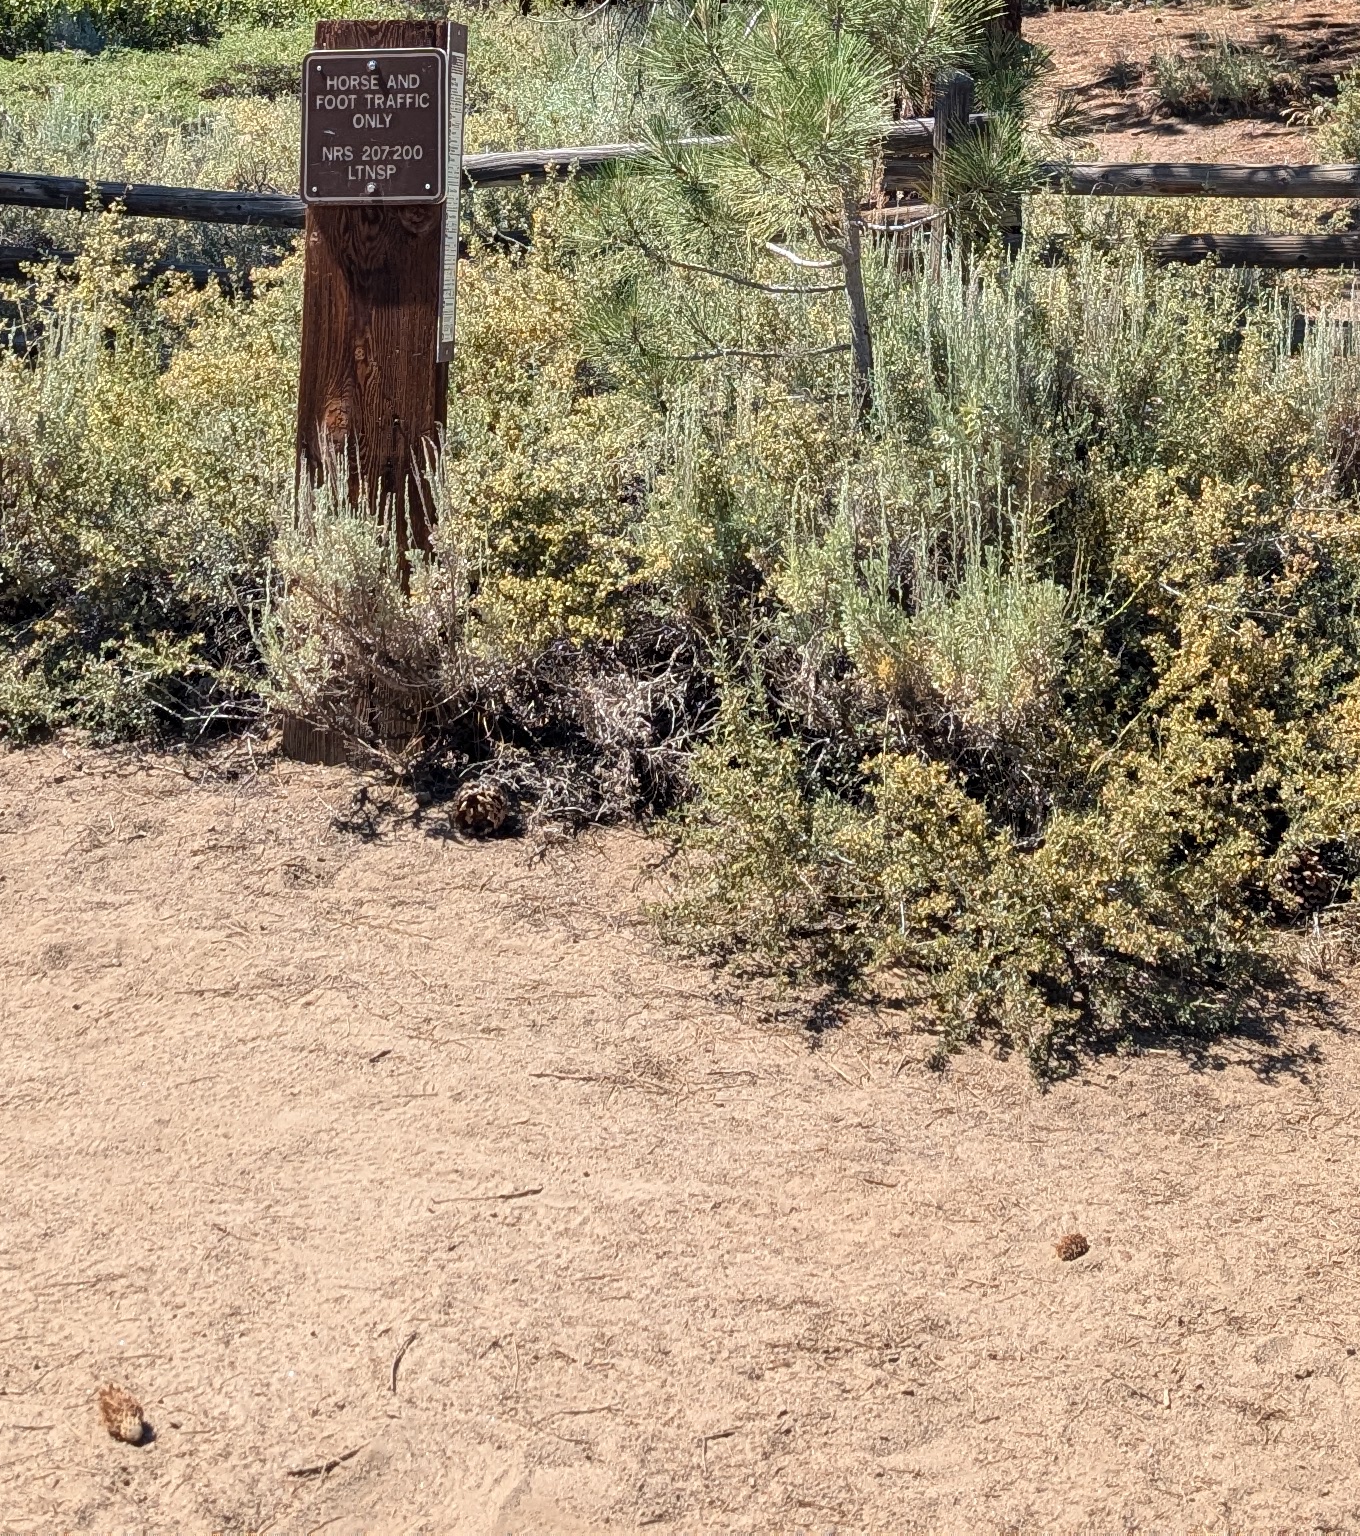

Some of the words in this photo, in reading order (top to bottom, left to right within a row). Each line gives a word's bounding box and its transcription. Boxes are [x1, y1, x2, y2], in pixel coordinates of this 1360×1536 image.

[326, 75, 380, 91] HORSE
[386, 74, 420, 89] AND
[316, 95, 357, 109] FOOT
[365, 93, 430, 109] TRAFFIC
[352, 114, 393, 128] ONLY
[322, 146, 354, 161] NRS
[362, 145, 423, 161] 207.200
[348, 165, 397, 180] LTNSP
